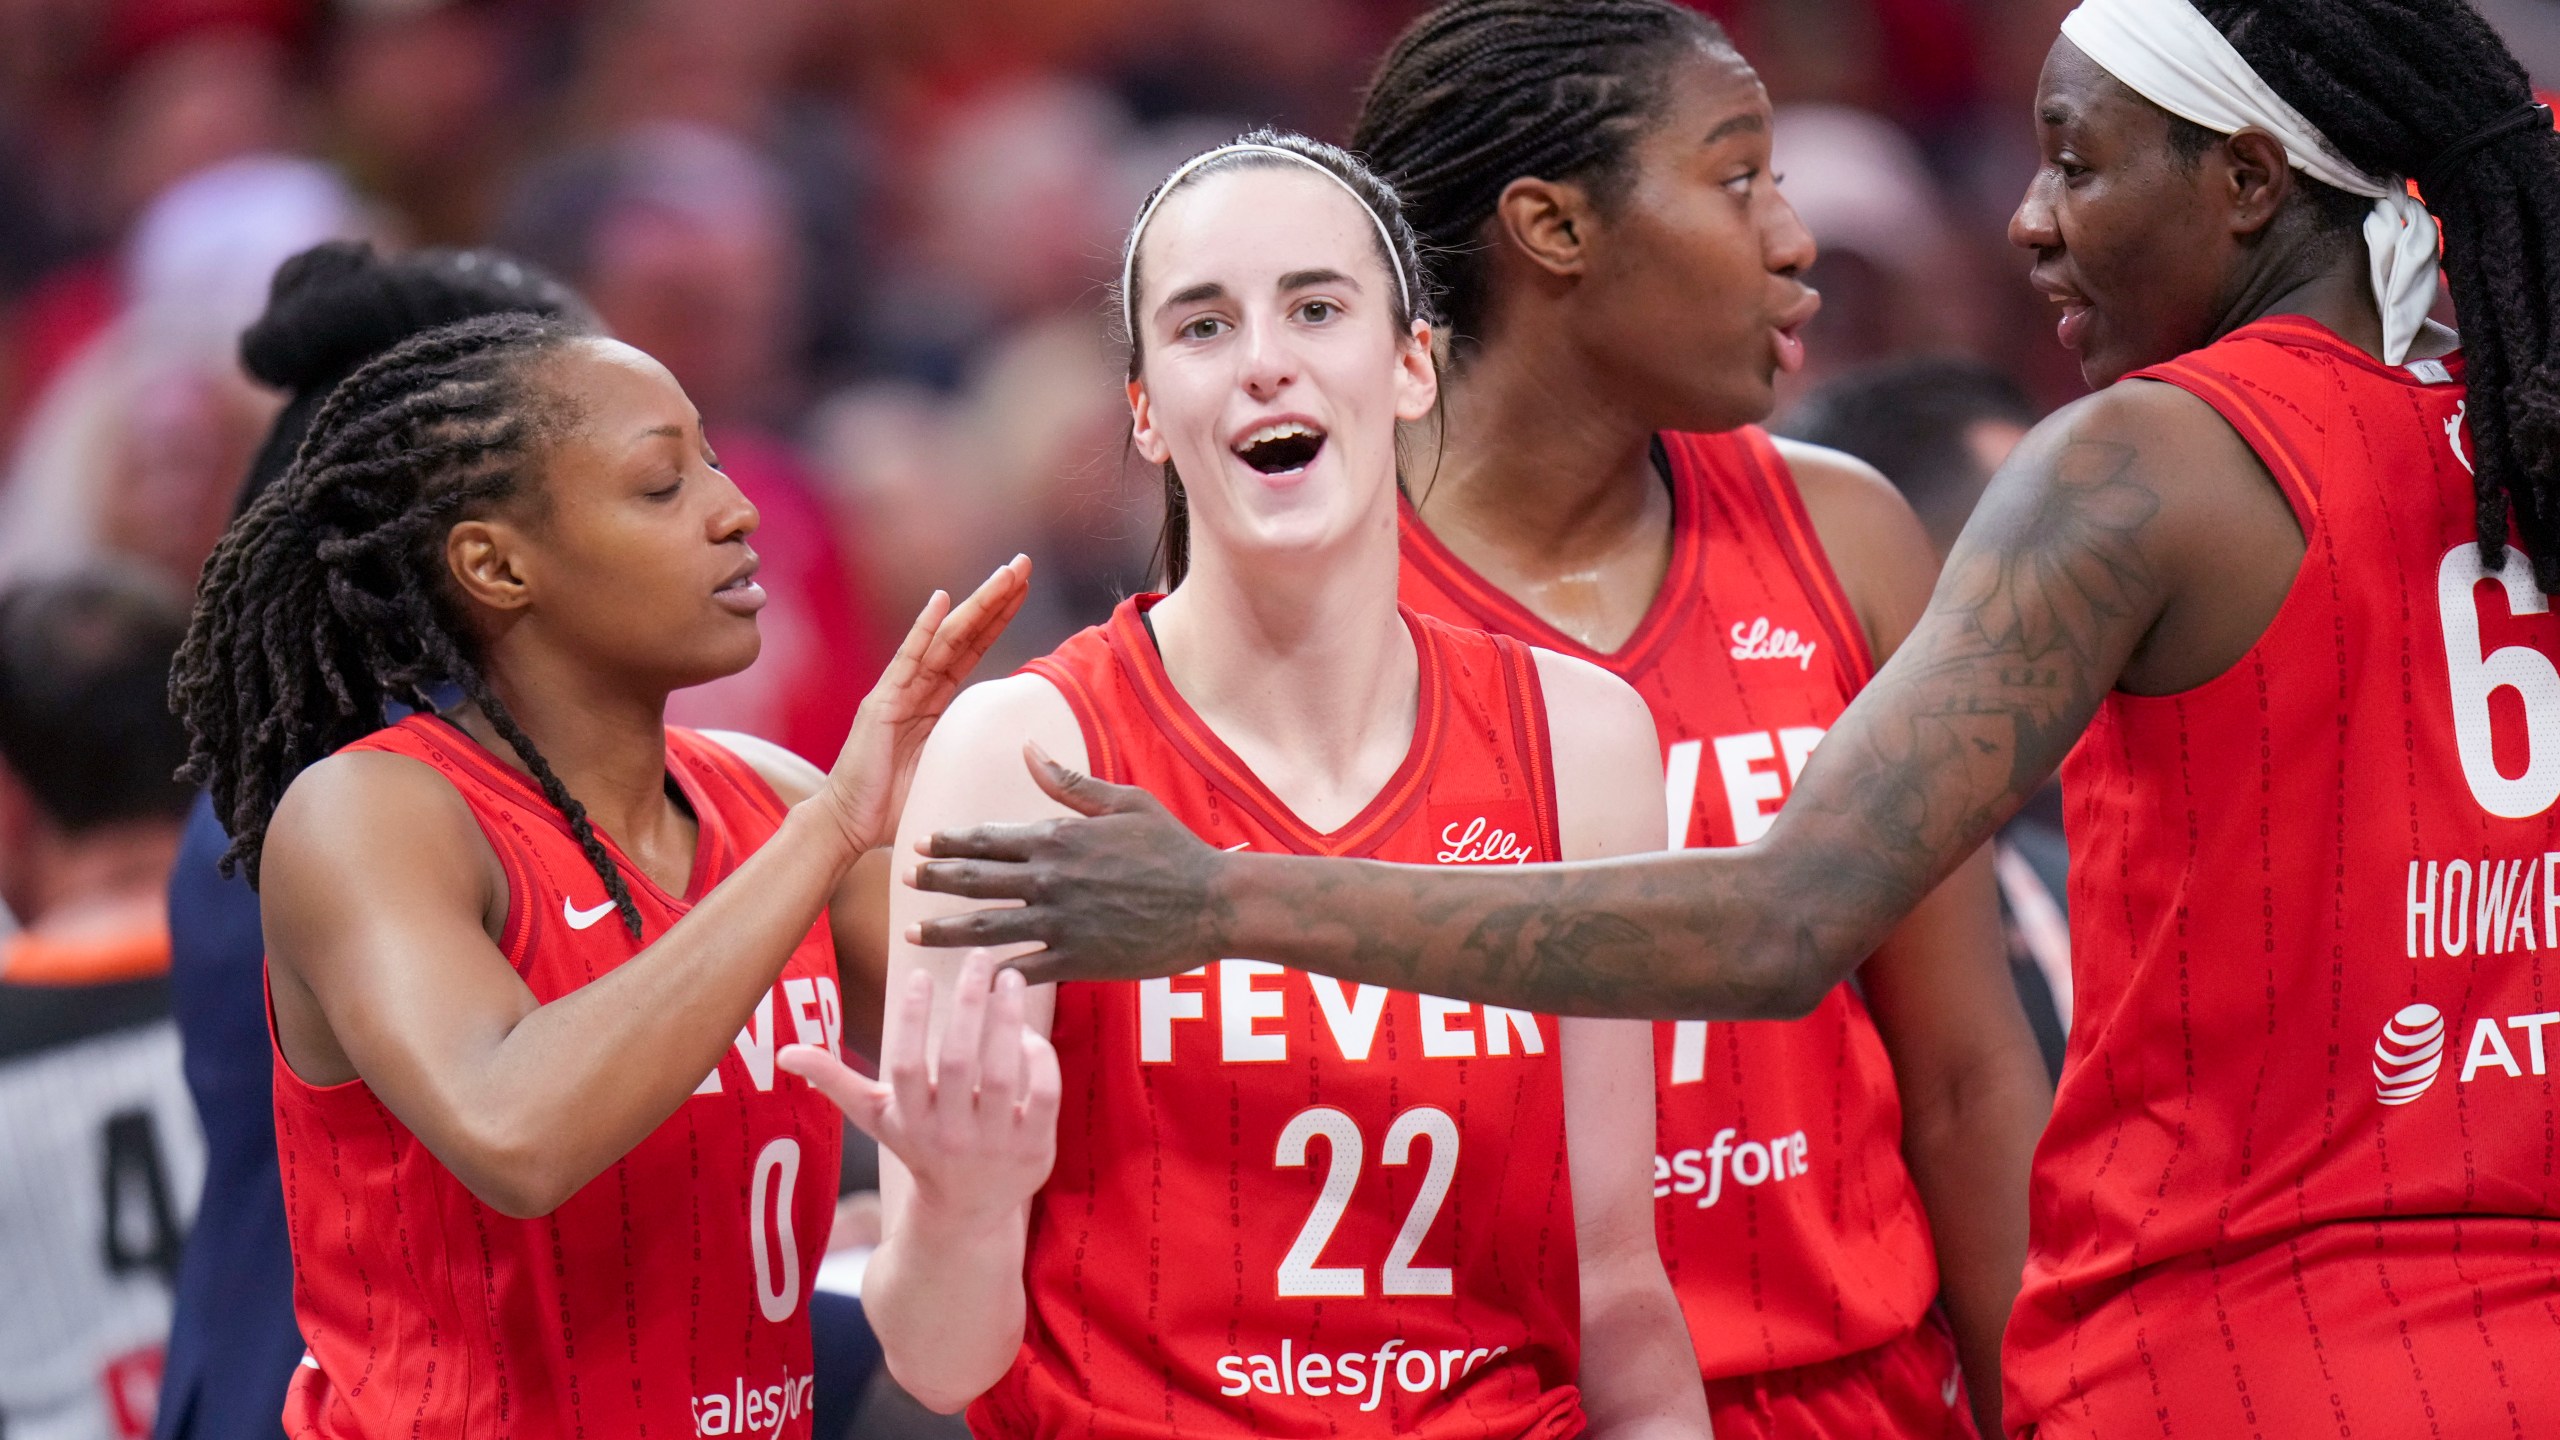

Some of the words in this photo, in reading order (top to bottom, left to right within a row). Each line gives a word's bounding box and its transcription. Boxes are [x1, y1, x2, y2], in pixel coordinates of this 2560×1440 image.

[1730, 616, 1817, 671] Lilly
[2436, 540, 2560, 820] 6
[1436, 816, 1533, 863] Lilly
[751, 1137, 801, 1324] 0
[1275, 1106, 1460, 1299] 22
[1216, 1338, 1508, 1412] salesfor
